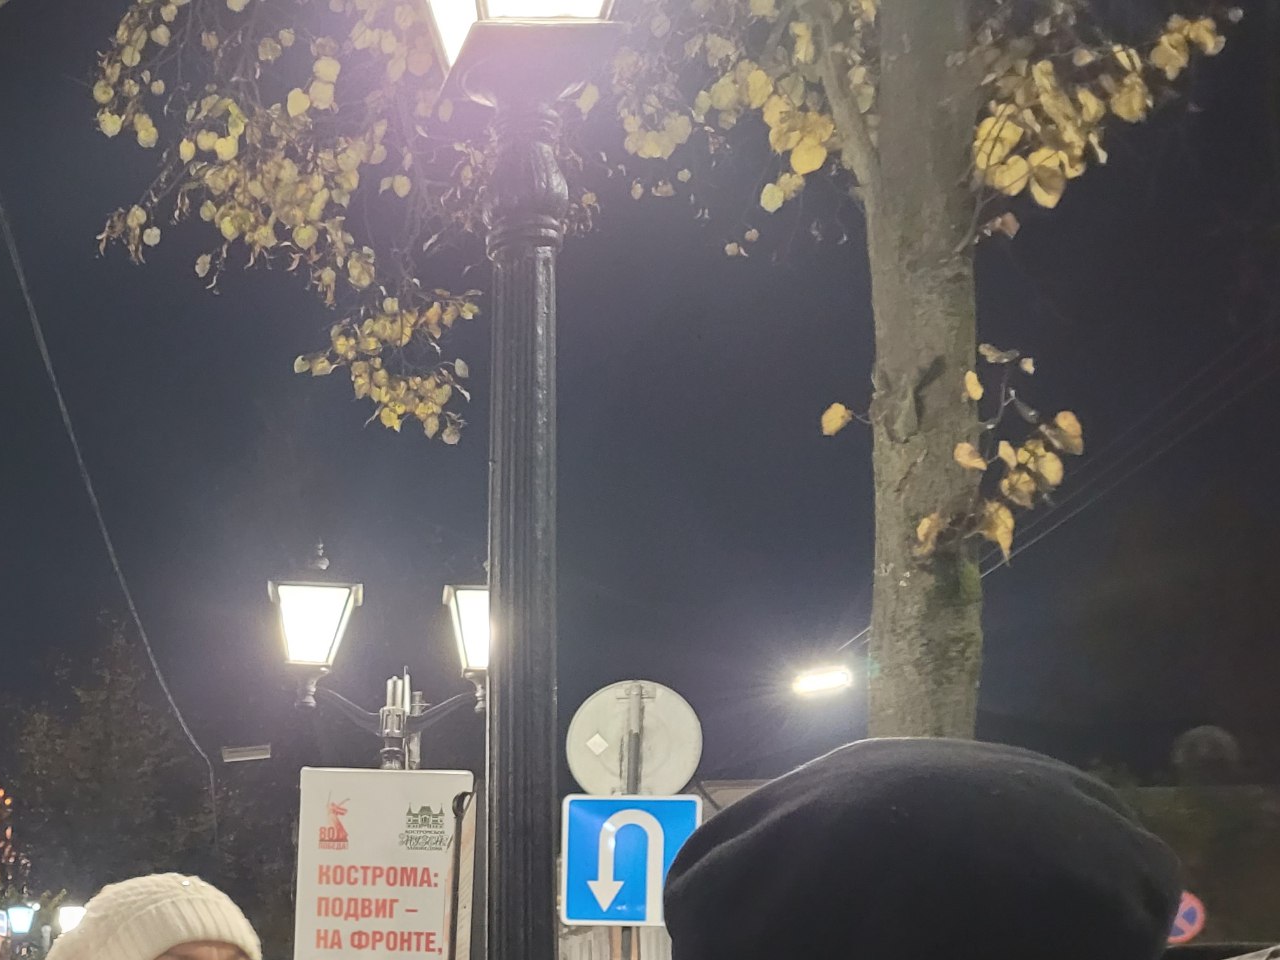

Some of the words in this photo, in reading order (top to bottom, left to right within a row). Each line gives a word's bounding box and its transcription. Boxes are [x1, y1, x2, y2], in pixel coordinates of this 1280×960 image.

[318, 864, 439, 888] КОСТРОМА:
[316, 896, 400, 921] ПОДВИГ
[315, 929, 343, 950] НА
[350, 930, 443, 955] ФРОНТЕ,
